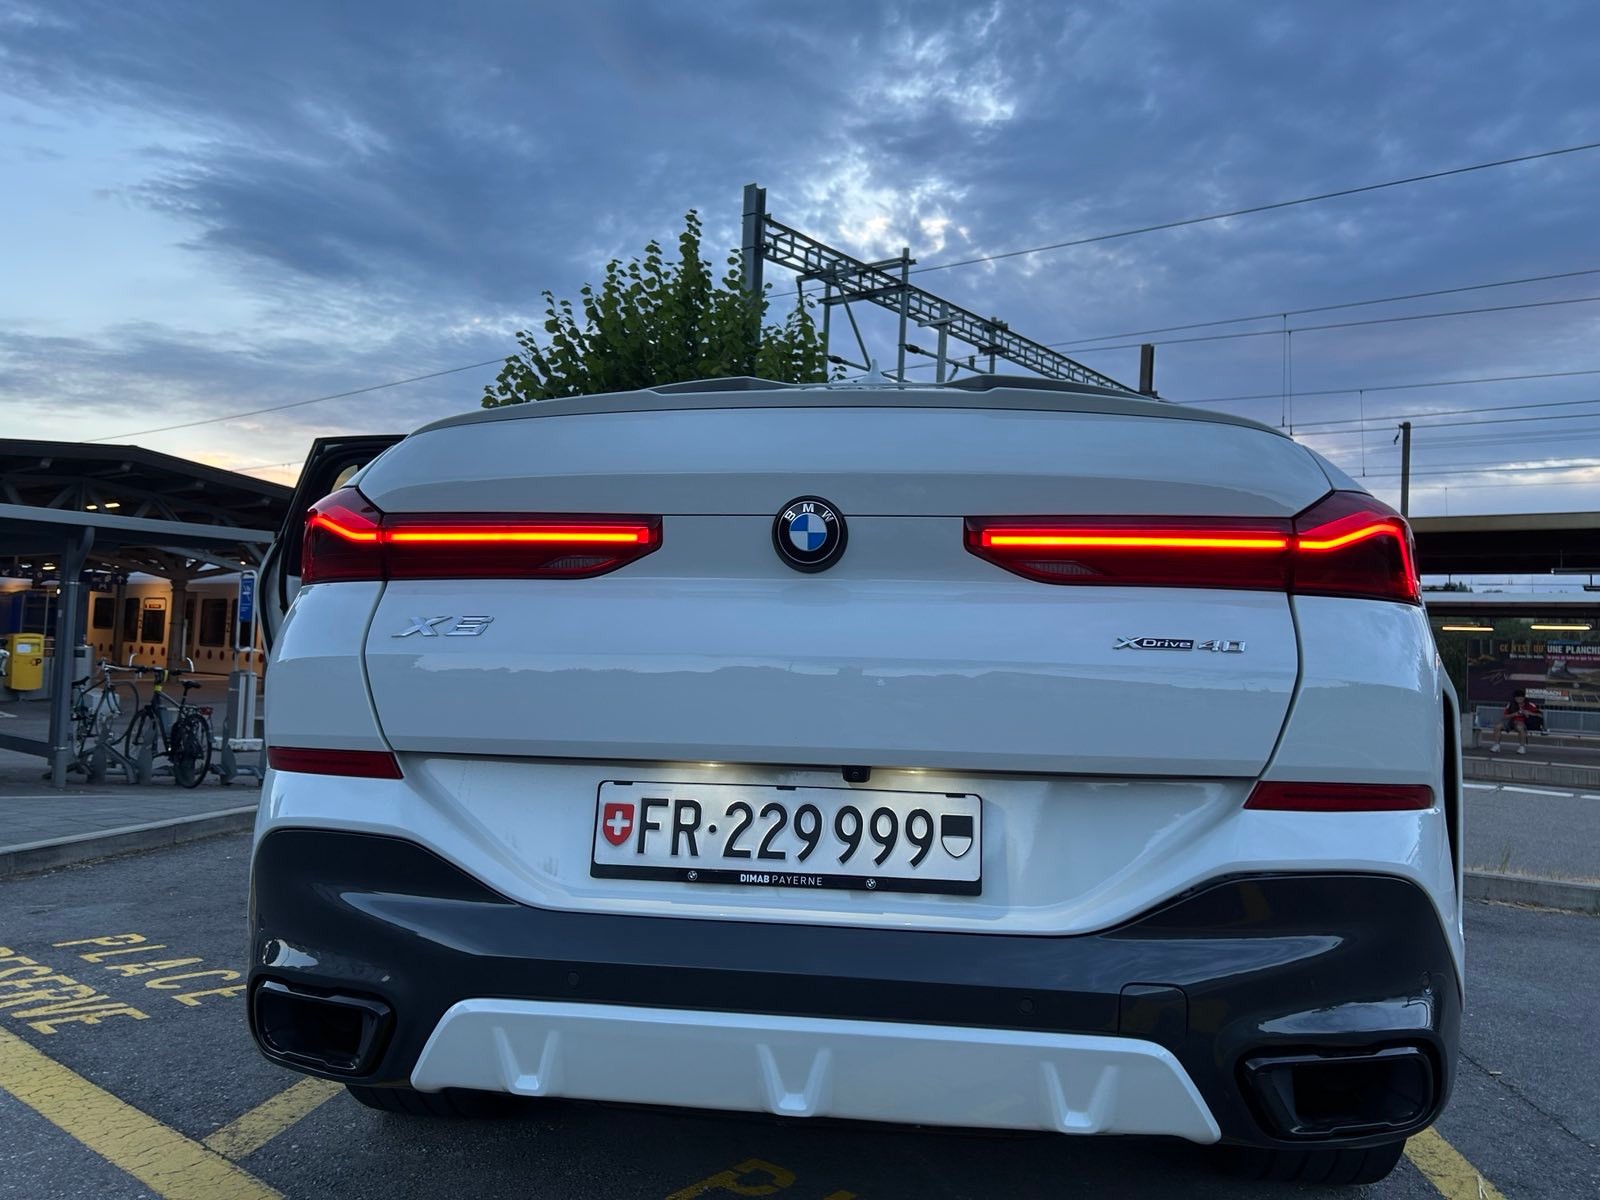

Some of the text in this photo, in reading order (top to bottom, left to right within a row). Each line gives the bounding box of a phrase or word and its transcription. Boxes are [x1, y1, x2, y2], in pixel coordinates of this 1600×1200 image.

[784, 503, 834, 522] BMW
[391, 615, 494, 638] X6
[1197, 640, 1246, 652] 40
[1547, 644, 1563, 654] UNE
[740, 874, 823, 887] DIMAB PAYERNE
[52, 933, 247, 1006] PLACE
